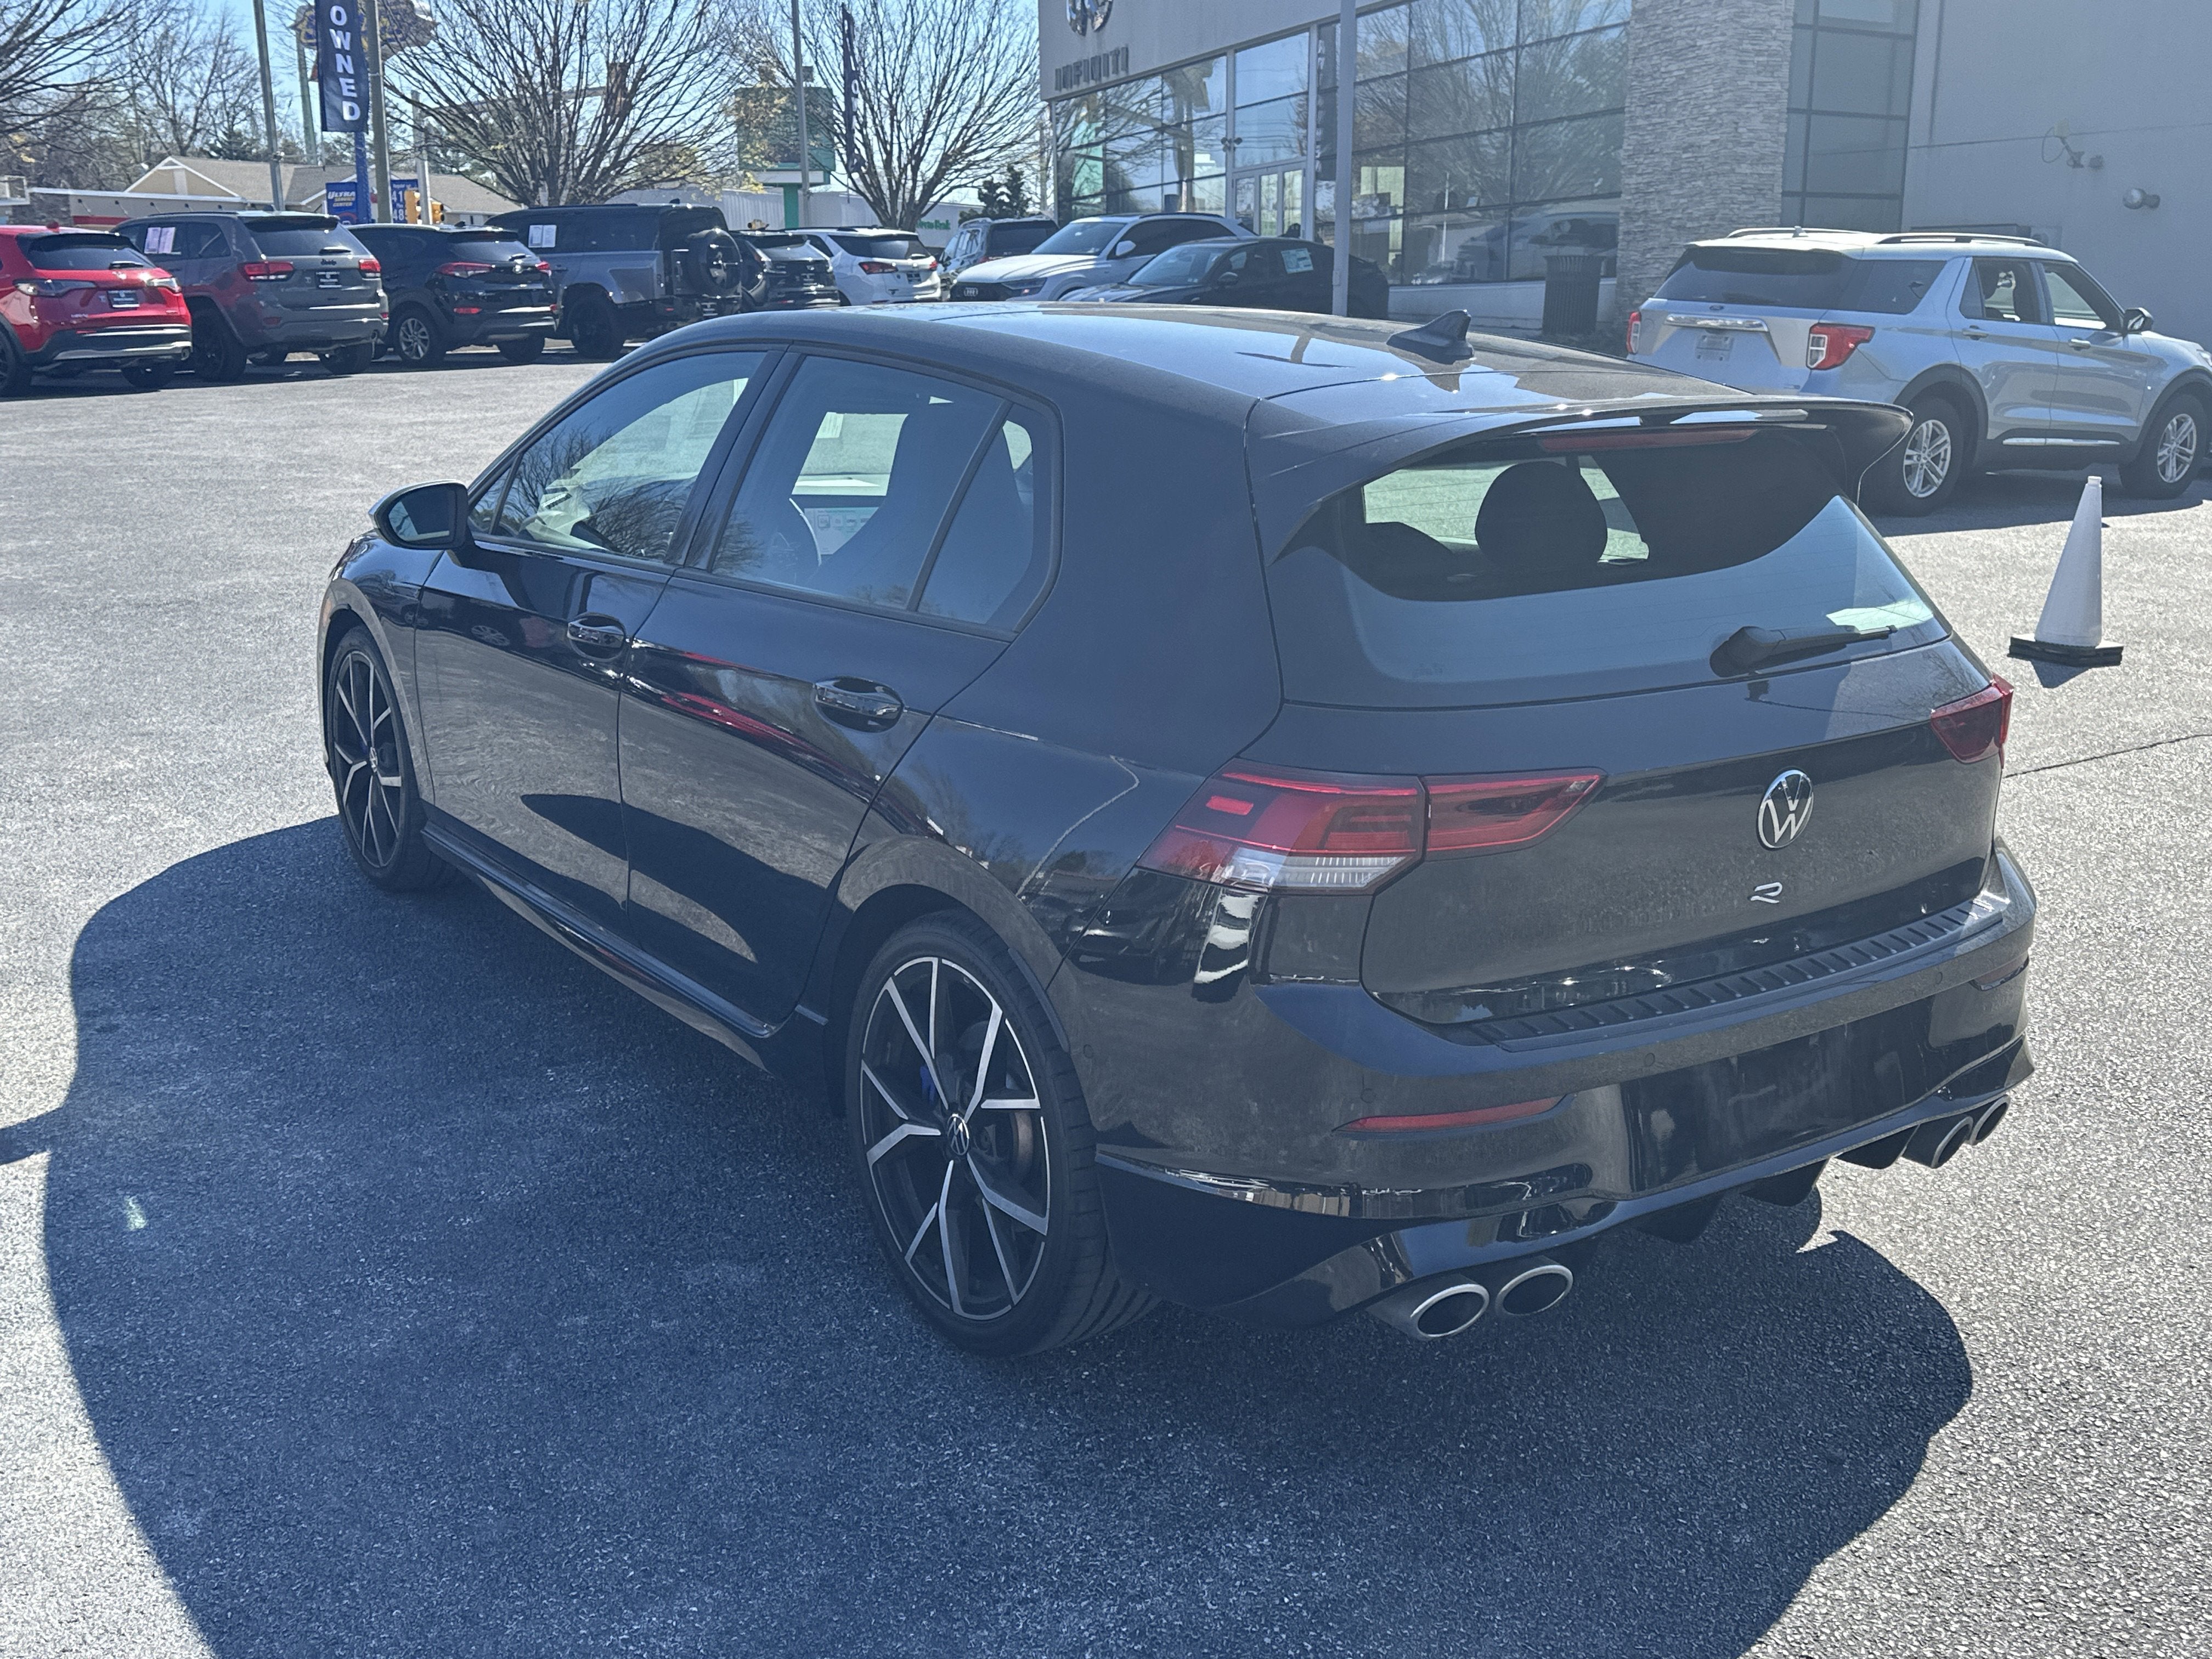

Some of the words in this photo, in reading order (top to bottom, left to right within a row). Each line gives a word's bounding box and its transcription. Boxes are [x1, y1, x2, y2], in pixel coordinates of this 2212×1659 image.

[329, 5, 360, 121] OWNED
[1054, 44, 1128, 92] INFINITI
[328, 191, 356, 199] ULTRA
[1750, 882, 1782, 904] R
